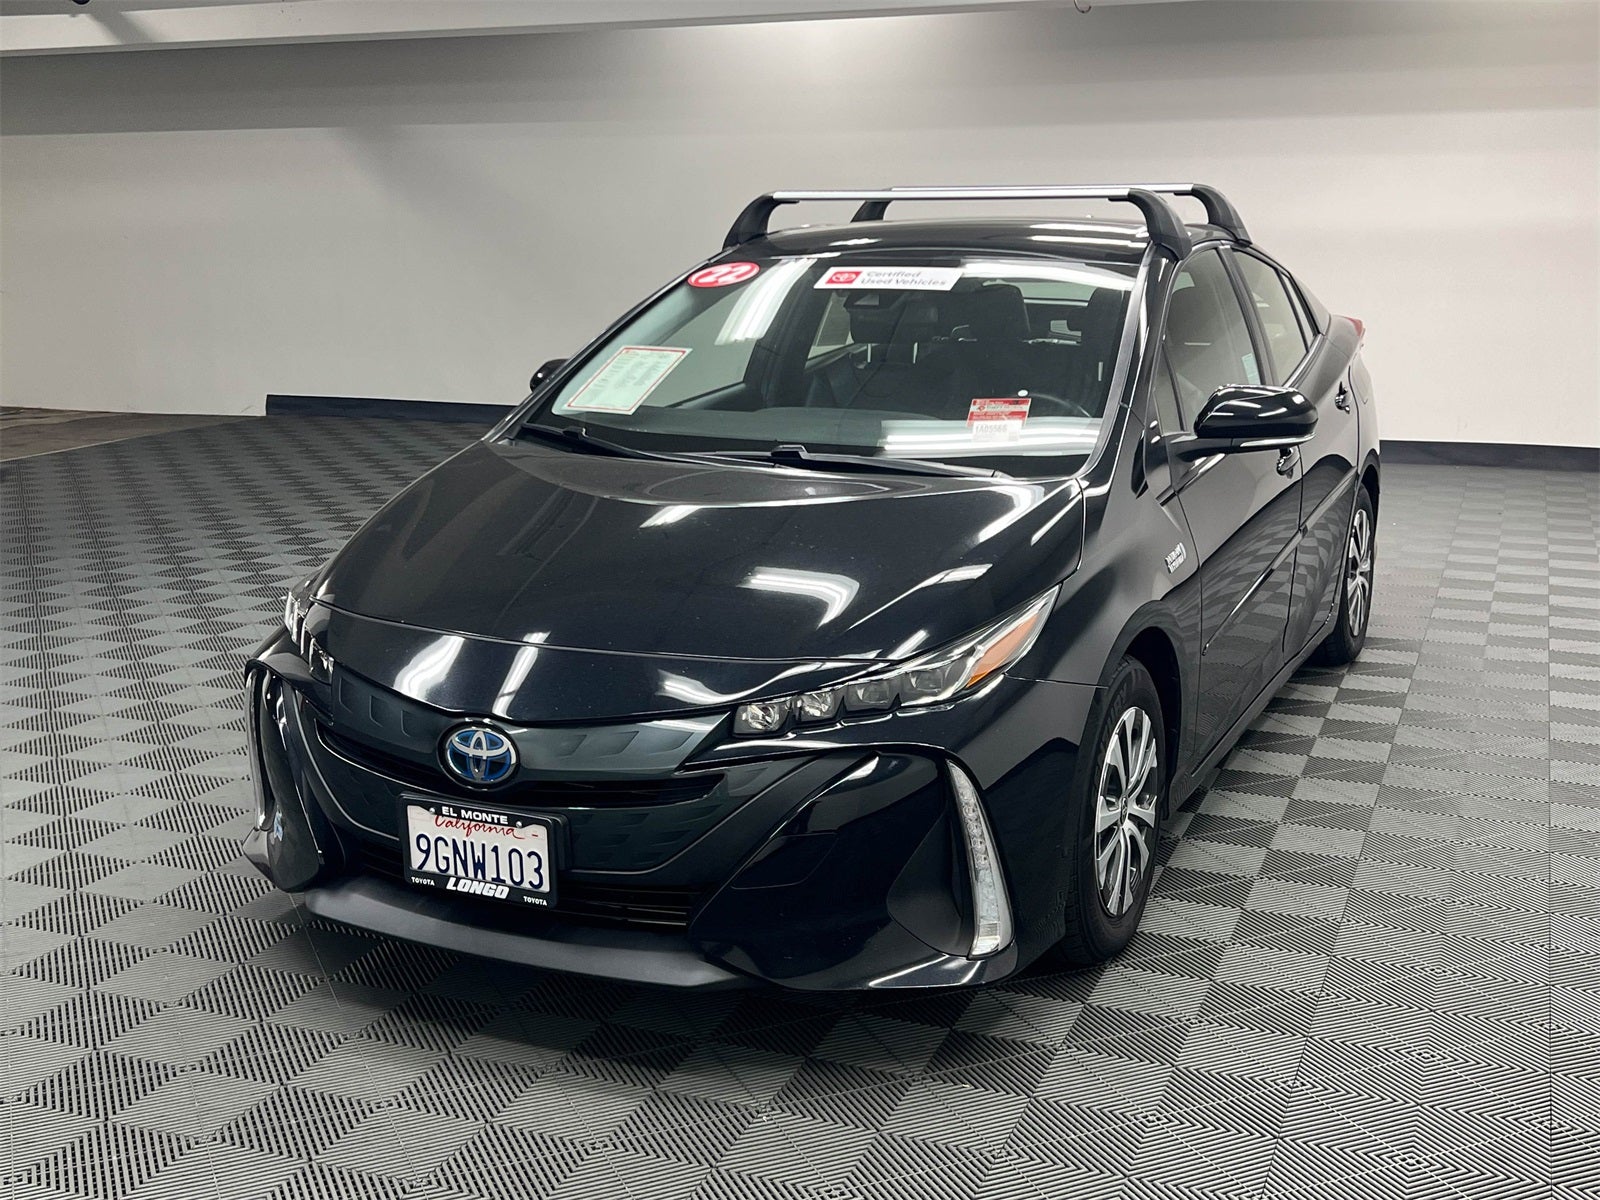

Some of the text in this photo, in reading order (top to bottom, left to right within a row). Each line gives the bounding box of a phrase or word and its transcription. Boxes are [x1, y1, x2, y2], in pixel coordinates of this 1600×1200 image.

[695, 264, 753, 286] 22
[866, 270, 921, 278] Certified
[441, 806, 509, 825] EL MONTE
[434, 815, 525, 840] California
[415, 833, 544, 890] 9GNW103
[411, 876, 435, 886] TOYOTA
[446, 877, 510, 900] LONGO
[523, 896, 548, 907] TOYOTA
